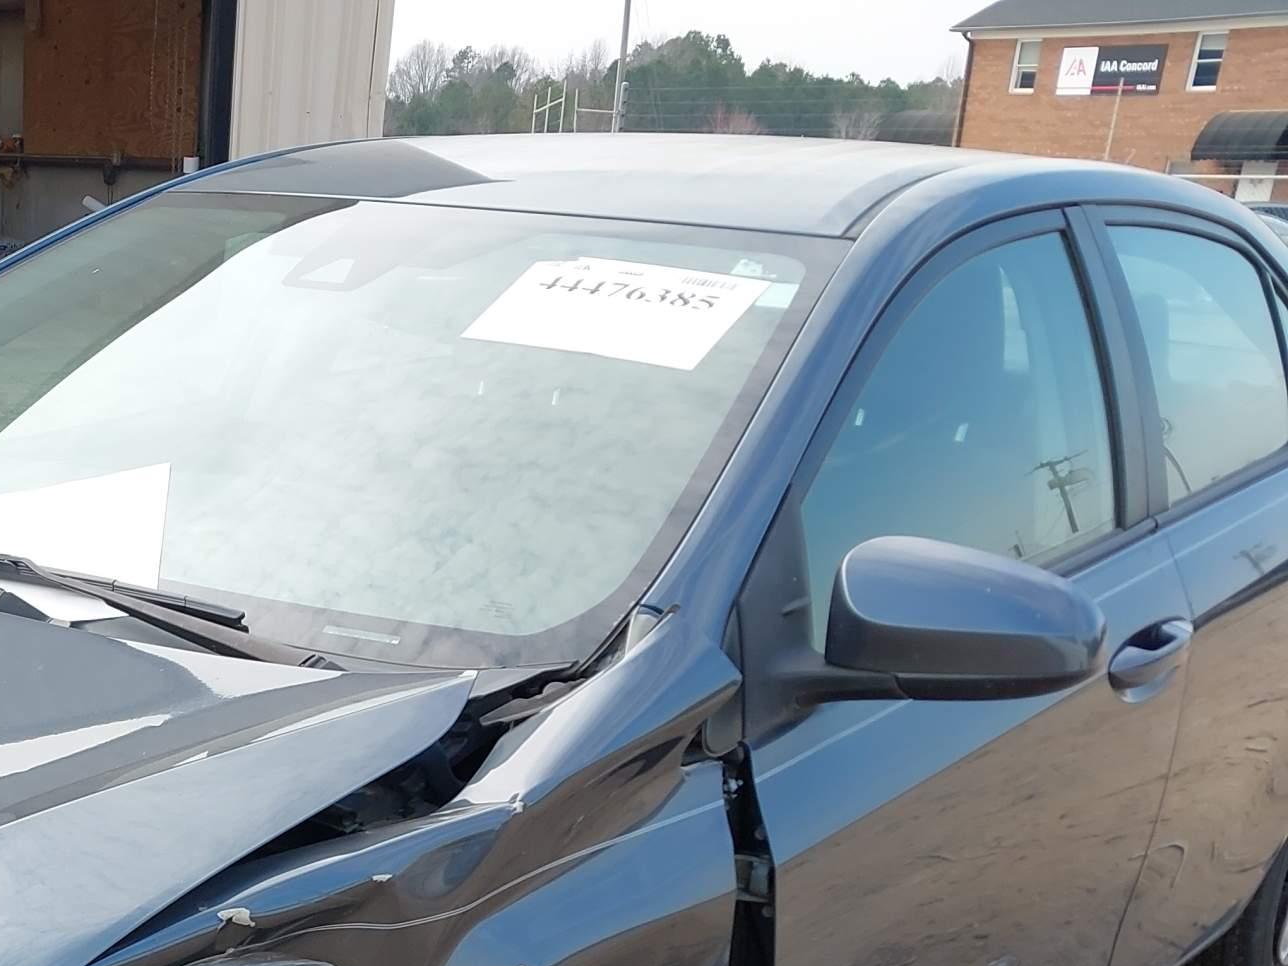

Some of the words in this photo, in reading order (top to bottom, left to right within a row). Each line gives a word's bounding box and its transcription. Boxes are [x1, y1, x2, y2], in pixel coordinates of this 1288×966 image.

[1099, 60, 1118, 73] IAA
[1119, 58, 1159, 73] Concord
[539, 276, 720, 310] 44476385
